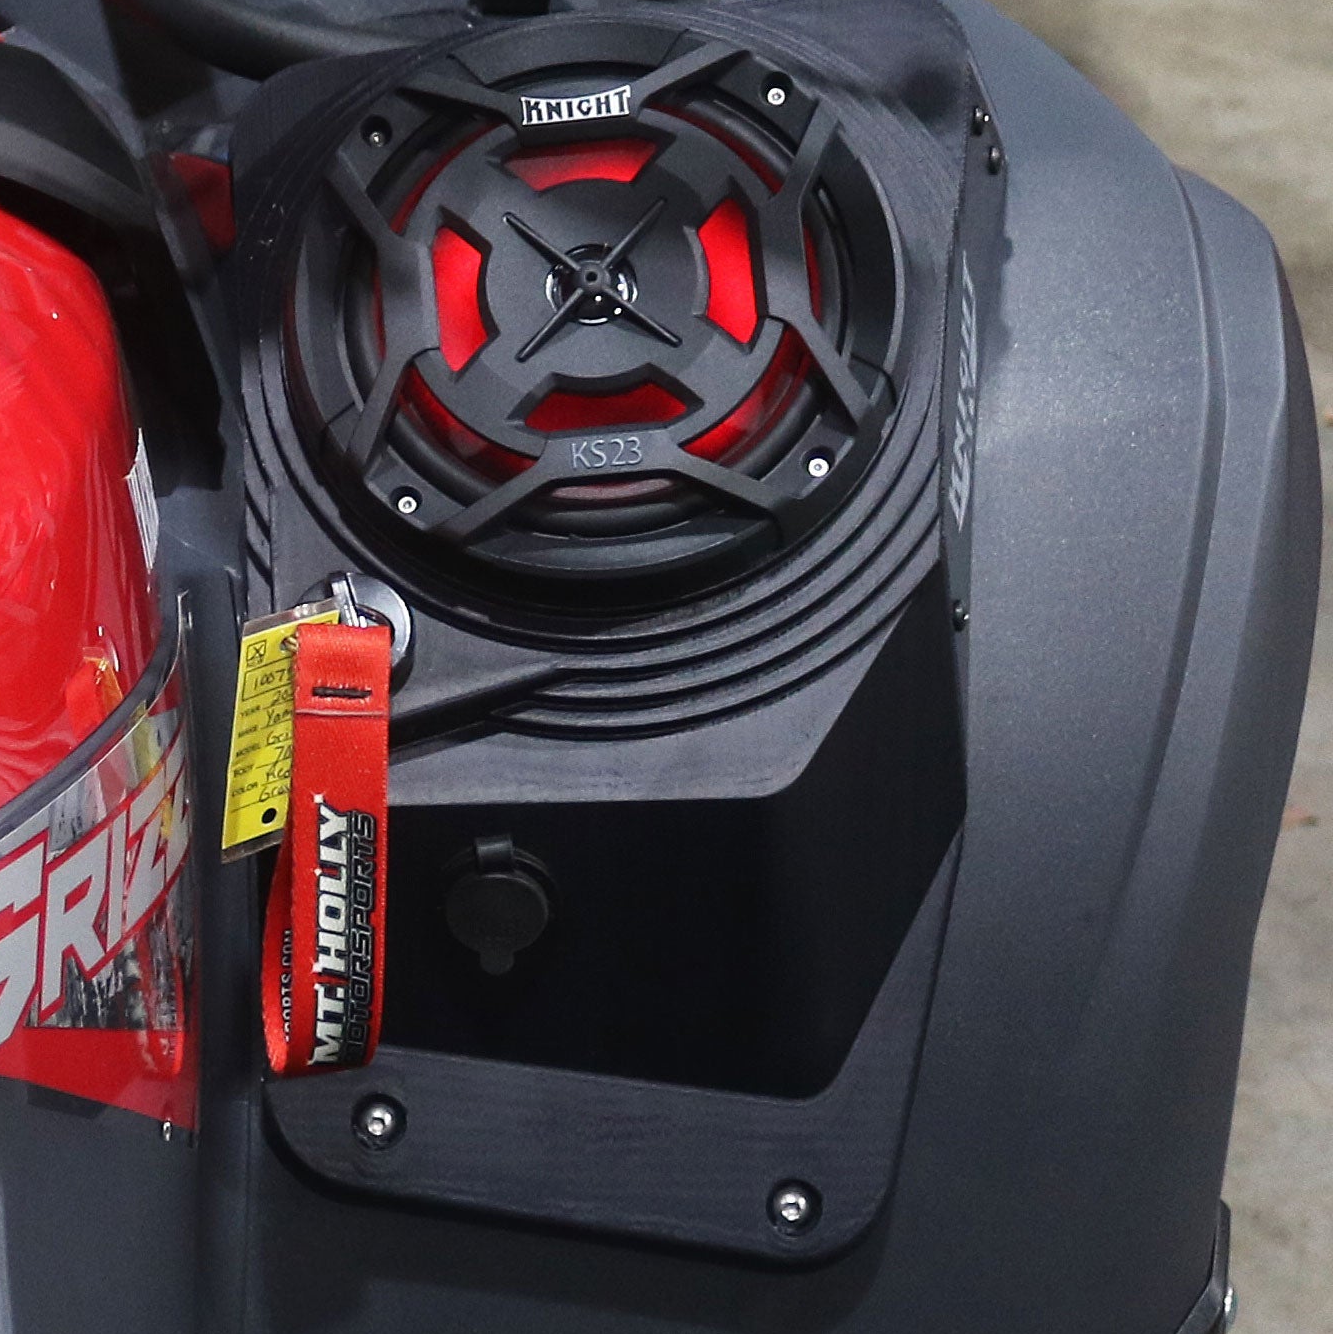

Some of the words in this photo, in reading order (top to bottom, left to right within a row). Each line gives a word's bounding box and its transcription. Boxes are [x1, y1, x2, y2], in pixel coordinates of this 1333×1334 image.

[524, 89, 628, 124] KNIGHT
[570, 436, 643, 469] KS23
[315, 805, 349, 973] HOLLY
[310, 985, 344, 1065] MT.
